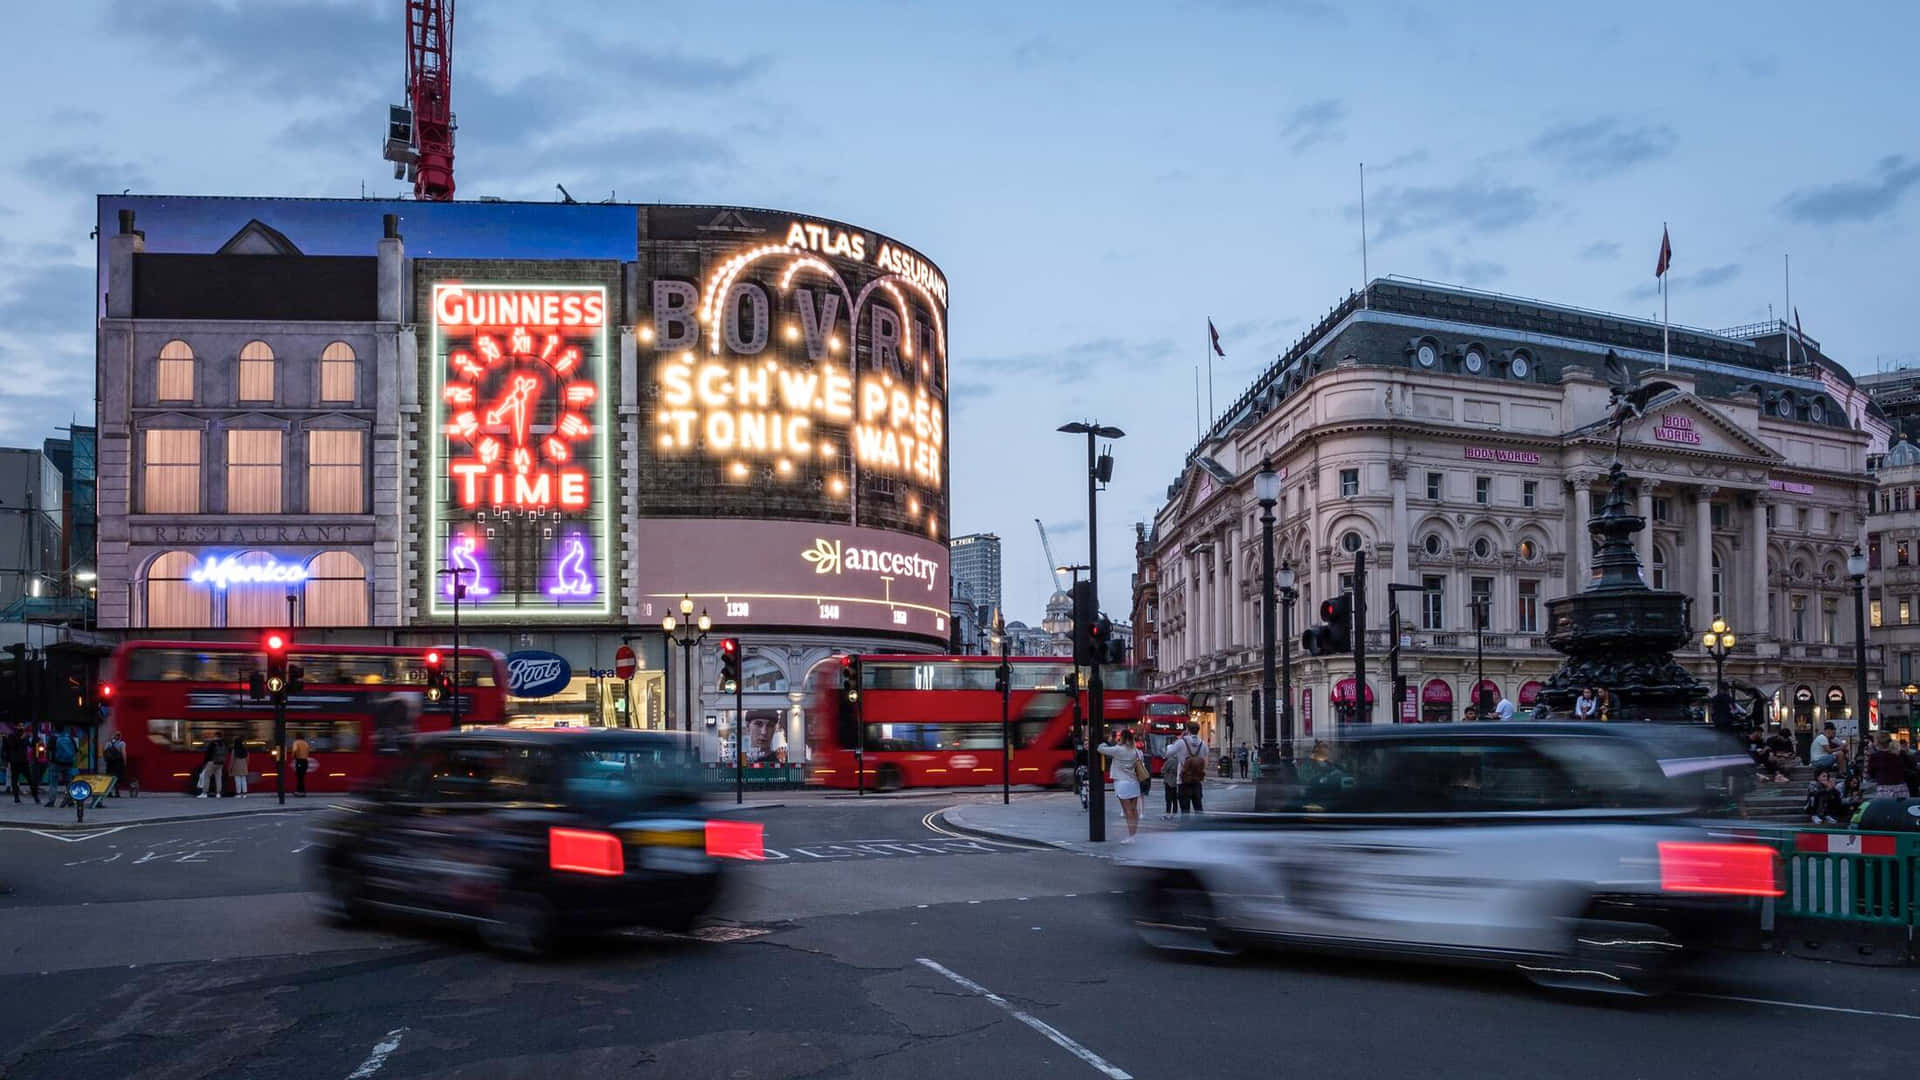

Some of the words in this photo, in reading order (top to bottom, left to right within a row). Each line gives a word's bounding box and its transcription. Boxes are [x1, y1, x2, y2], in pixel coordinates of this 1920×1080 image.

[786, 223, 866, 261] ATLAS
[653, 280, 943, 401] BOVRIL
[664, 362, 943, 445] SCHWEPPES
[1654, 427, 1703, 445] WORLDS
[1663, 414, 1695, 431] BODY
[669, 410, 812, 452] TONIC
[855, 424, 941, 488] WATER
[1464, 446, 1496, 461] BODY
[155, 526, 352, 543] RESTAURANT
[845, 546, 939, 591] ancestry
[507, 658, 561, 690] Boots
